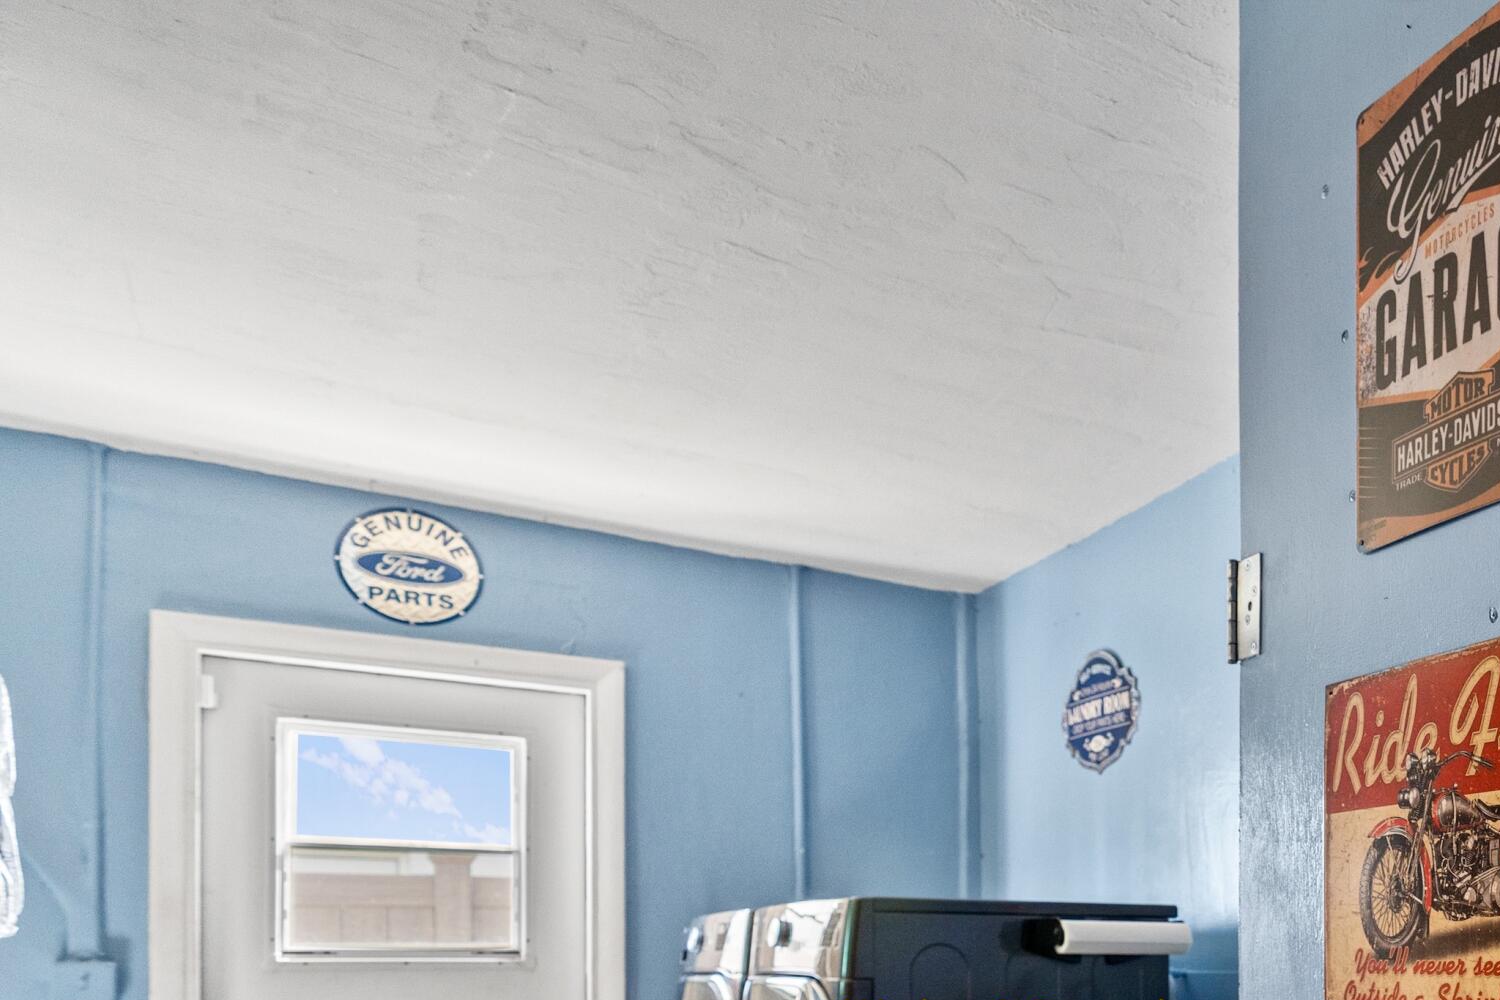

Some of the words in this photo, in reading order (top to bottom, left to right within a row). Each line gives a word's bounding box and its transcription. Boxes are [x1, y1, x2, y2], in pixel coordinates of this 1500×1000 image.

[1424, 203, 1496, 259] MOTORCYCLES
[1430, 376, 1486, 419] MOTOR
[1396, 474, 1423, 491] TRADE
[1430, 444, 1486, 484] CYCLES
[350, 515, 469, 559] GENUINE
[375, 554, 445, 582] Ford
[368, 586, 454, 609] PARTS
[1332, 673, 1439, 794] Ride
[1354, 946, 1409, 982] You'll
[1413, 958, 1466, 978] never
